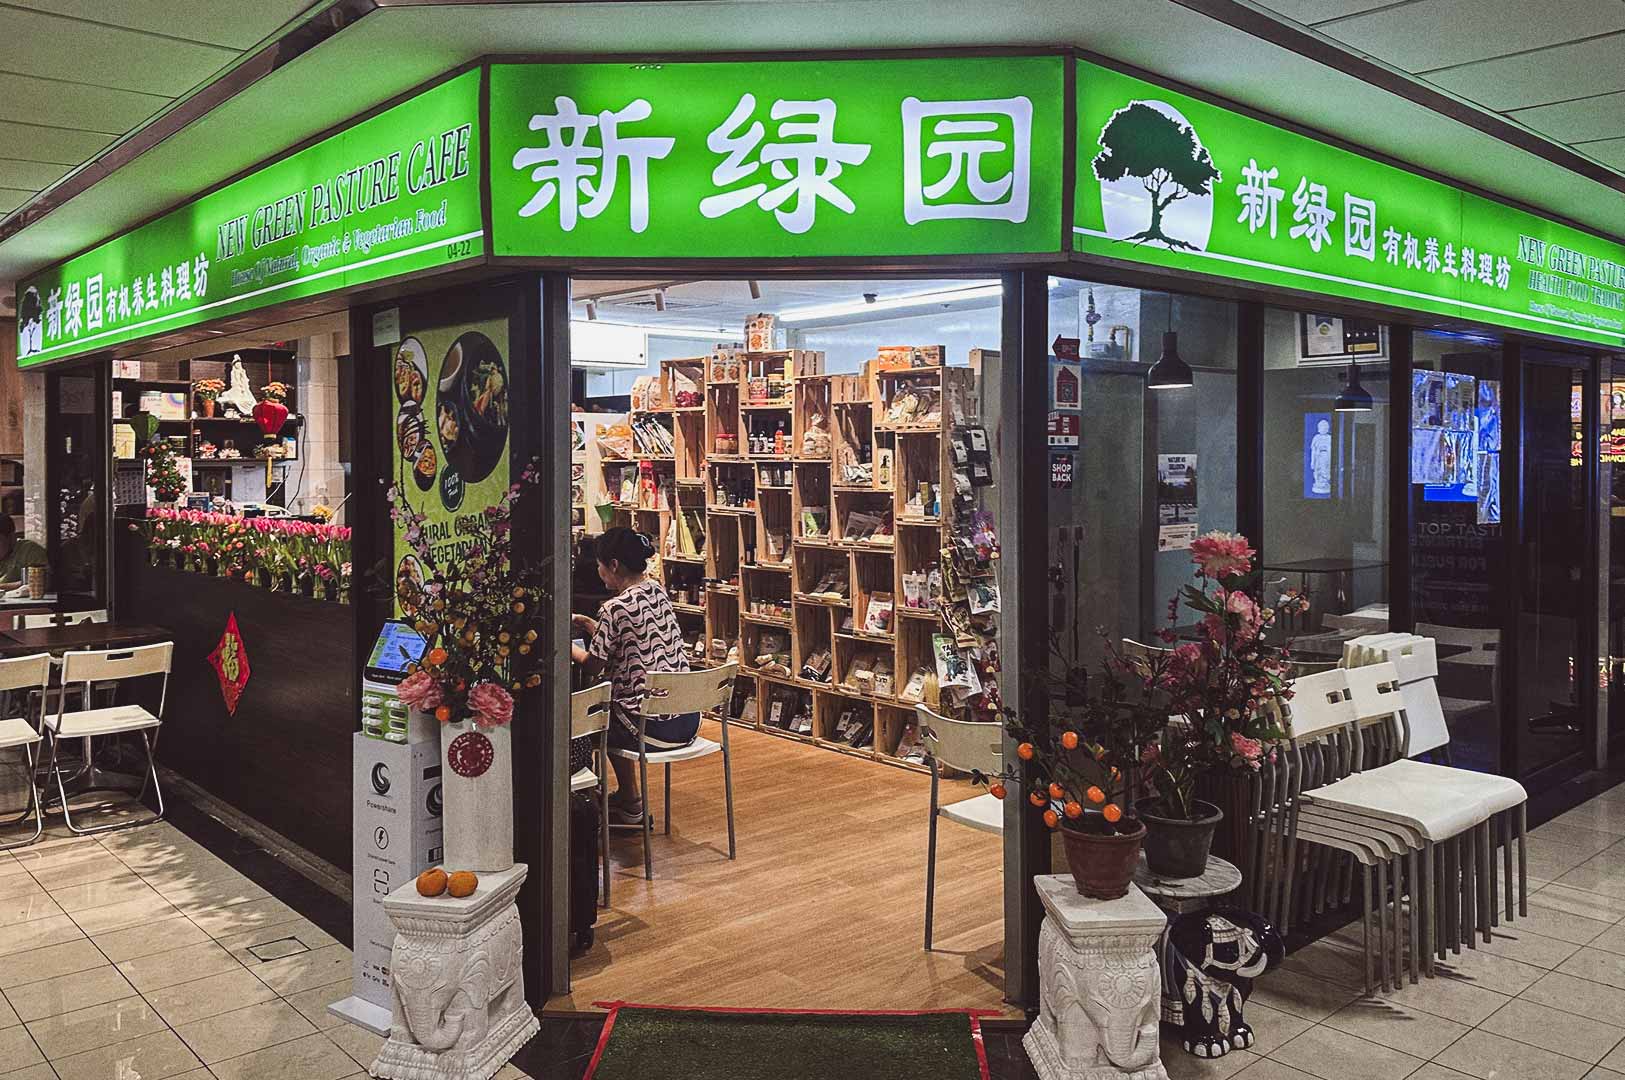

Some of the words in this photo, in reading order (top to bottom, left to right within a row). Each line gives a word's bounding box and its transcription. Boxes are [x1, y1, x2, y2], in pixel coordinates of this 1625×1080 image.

[513, 93, 1033, 233] 新绿园
[216, 215, 249, 262] NEW
[252, 190, 307, 249] GREEN
[309, 151, 402, 230] PASTURE
[406, 122, 472, 196] CAFE
[415, 199, 448, 235] Food
[1236, 158, 1377, 262] 新绿园
[1382, 225, 1512, 291] 有机养生料理坊
[447, 239, 473, 259] 04-22
[1517, 234, 1547, 268] NEW
[1548, 243, 1586, 280] GREEN
[46, 272, 104, 342] 新绿园
[105, 251, 210, 324] 有机养生料理坊
[1051, 463, 1072, 473] SHOP
[1051, 473, 1072, 483] BACK
[1417, 522, 1451, 535] TOP
